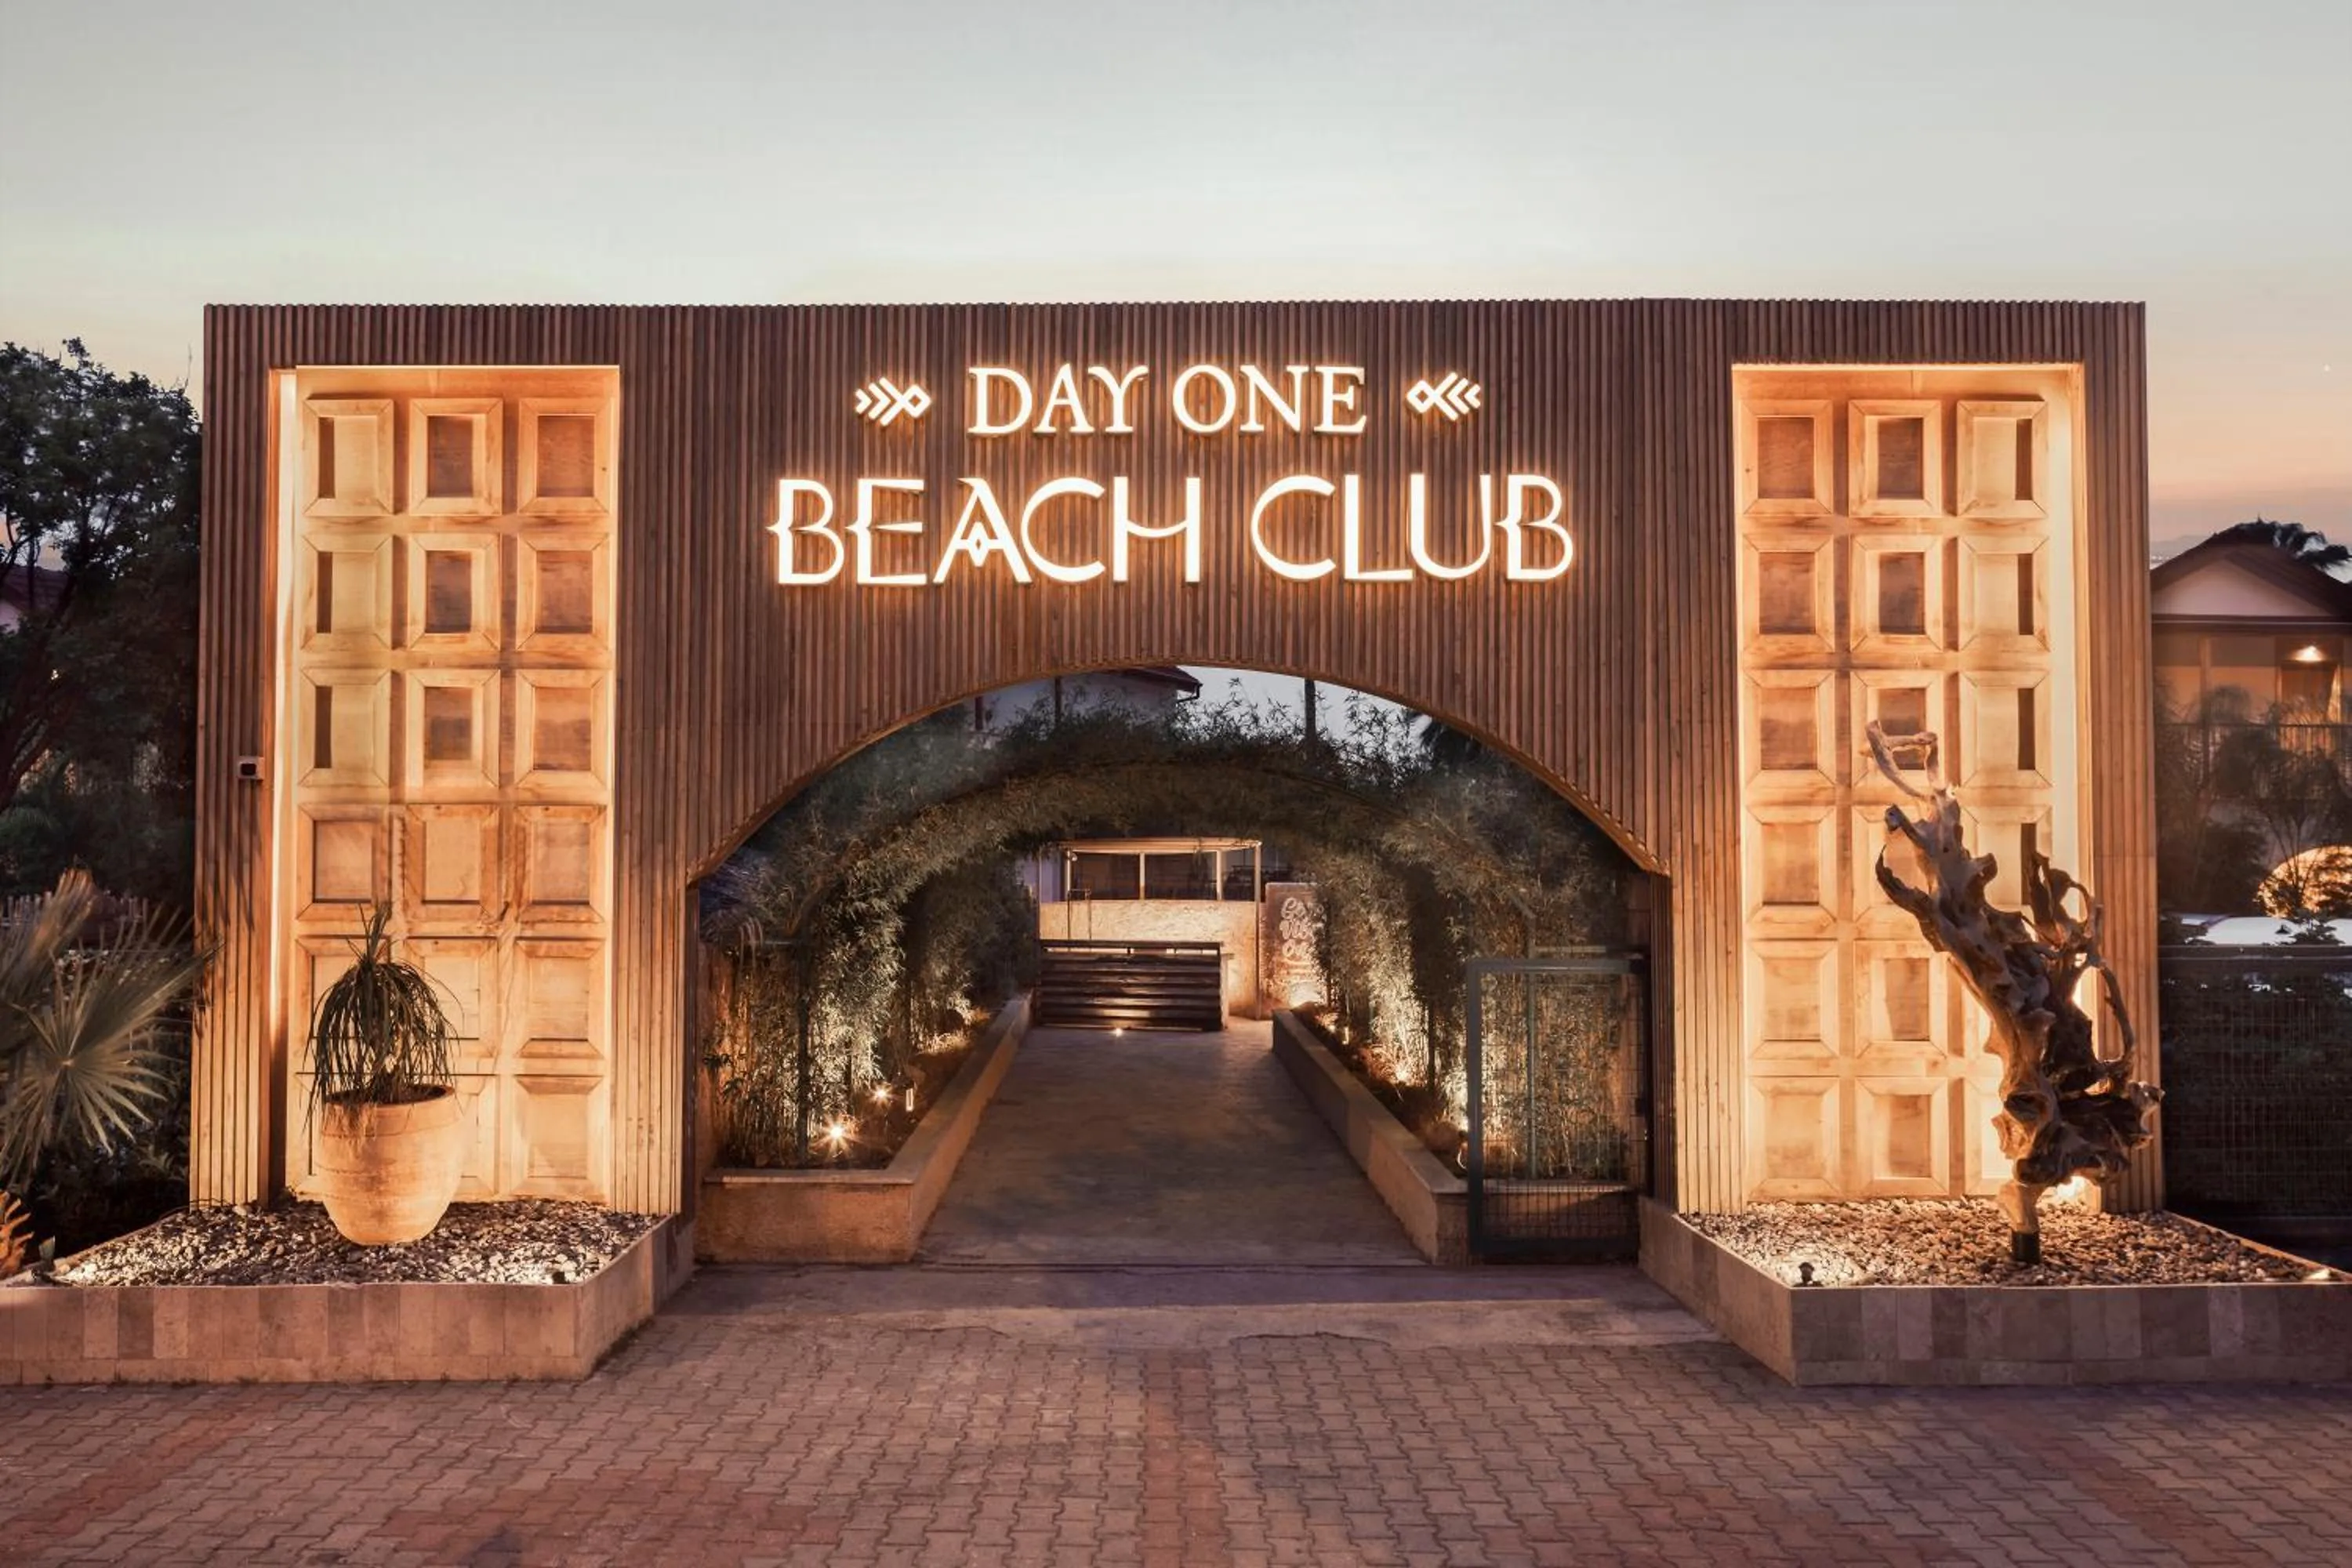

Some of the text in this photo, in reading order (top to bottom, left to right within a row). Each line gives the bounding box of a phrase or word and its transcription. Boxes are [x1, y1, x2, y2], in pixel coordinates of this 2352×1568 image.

[968, 364, 1367, 434] DAY ONE
[768, 474, 1573, 584] BEACH CLUB
